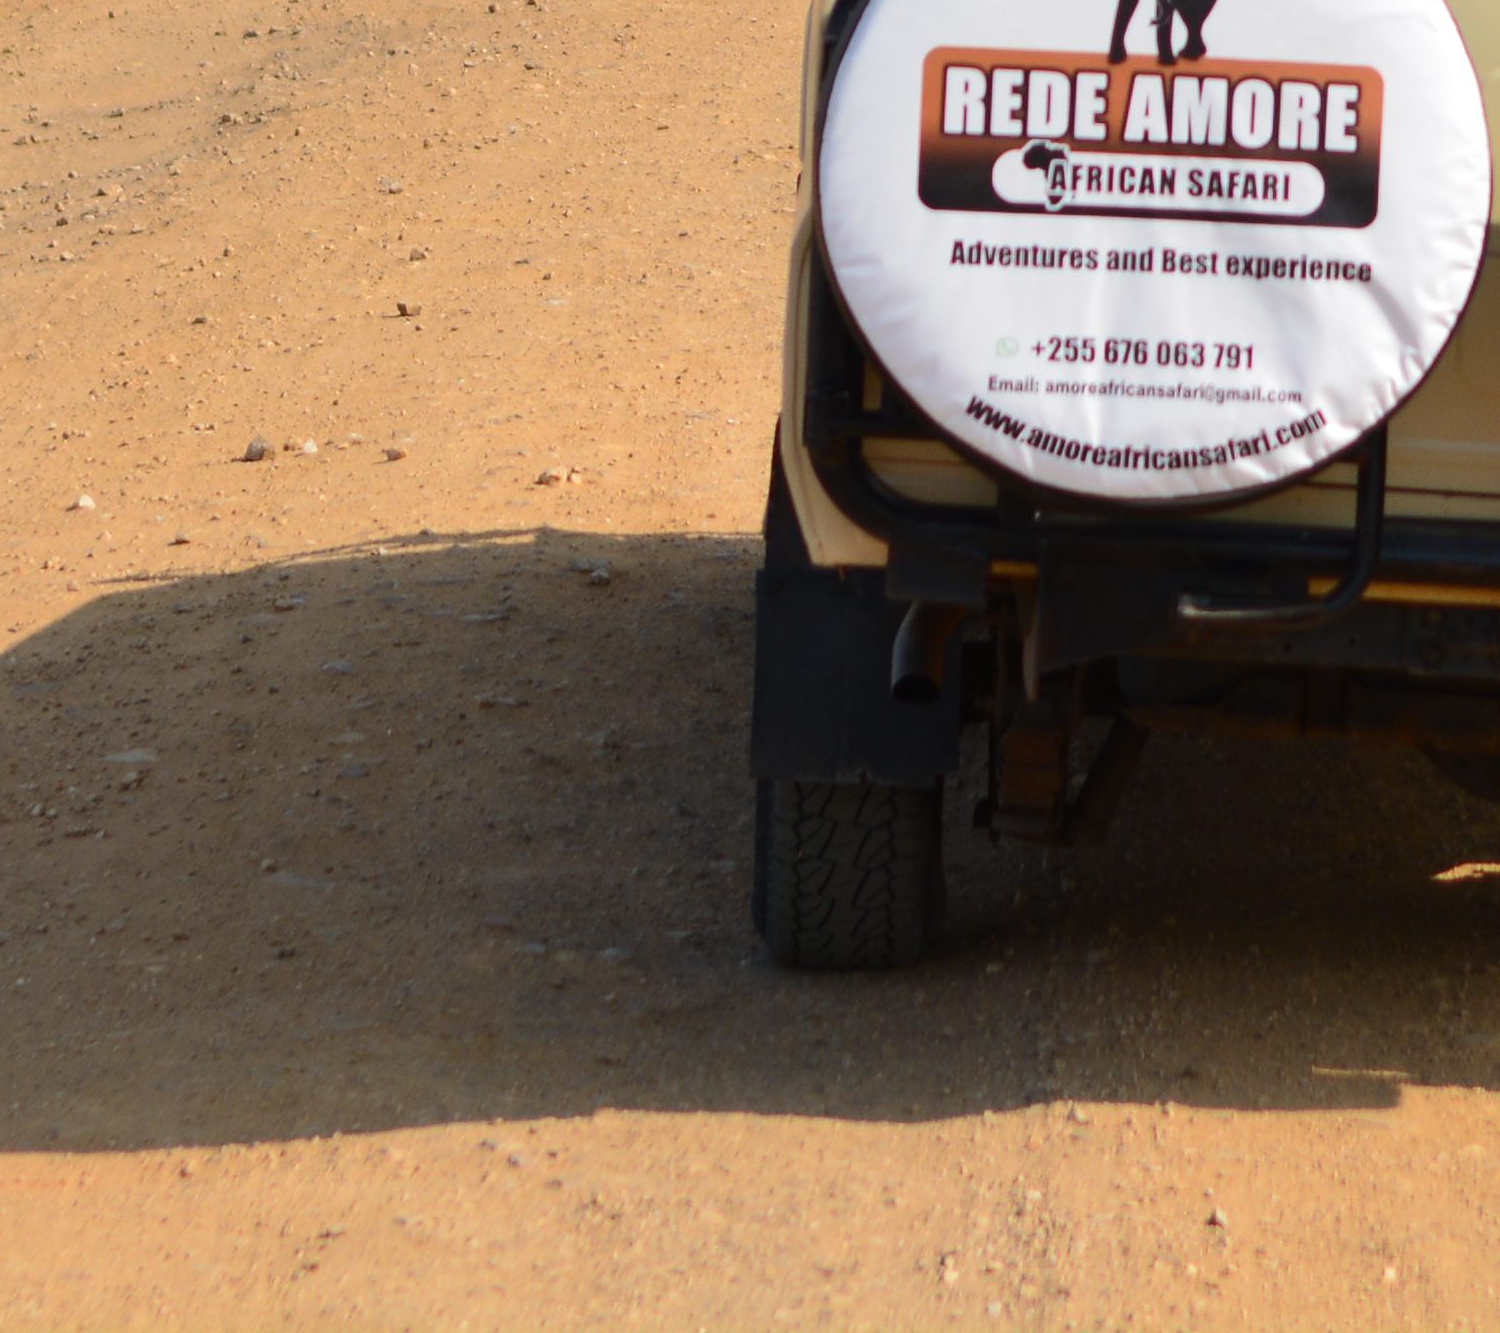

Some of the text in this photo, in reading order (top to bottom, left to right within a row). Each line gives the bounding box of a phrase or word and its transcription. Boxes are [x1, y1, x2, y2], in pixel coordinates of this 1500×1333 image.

[943, 65, 1361, 153] REDE AMORE
[1049, 162, 1291, 202] AFRICAN SAFARI
[950, 240, 1373, 283] Adventures and Best experience
[1031, 336, 1255, 370] +255 676 063 791
[987, 375, 1303, 405] Email: amoreafricansafari@gmail.com
[965, 394, 1329, 471] www.amoreafricansafari.com
